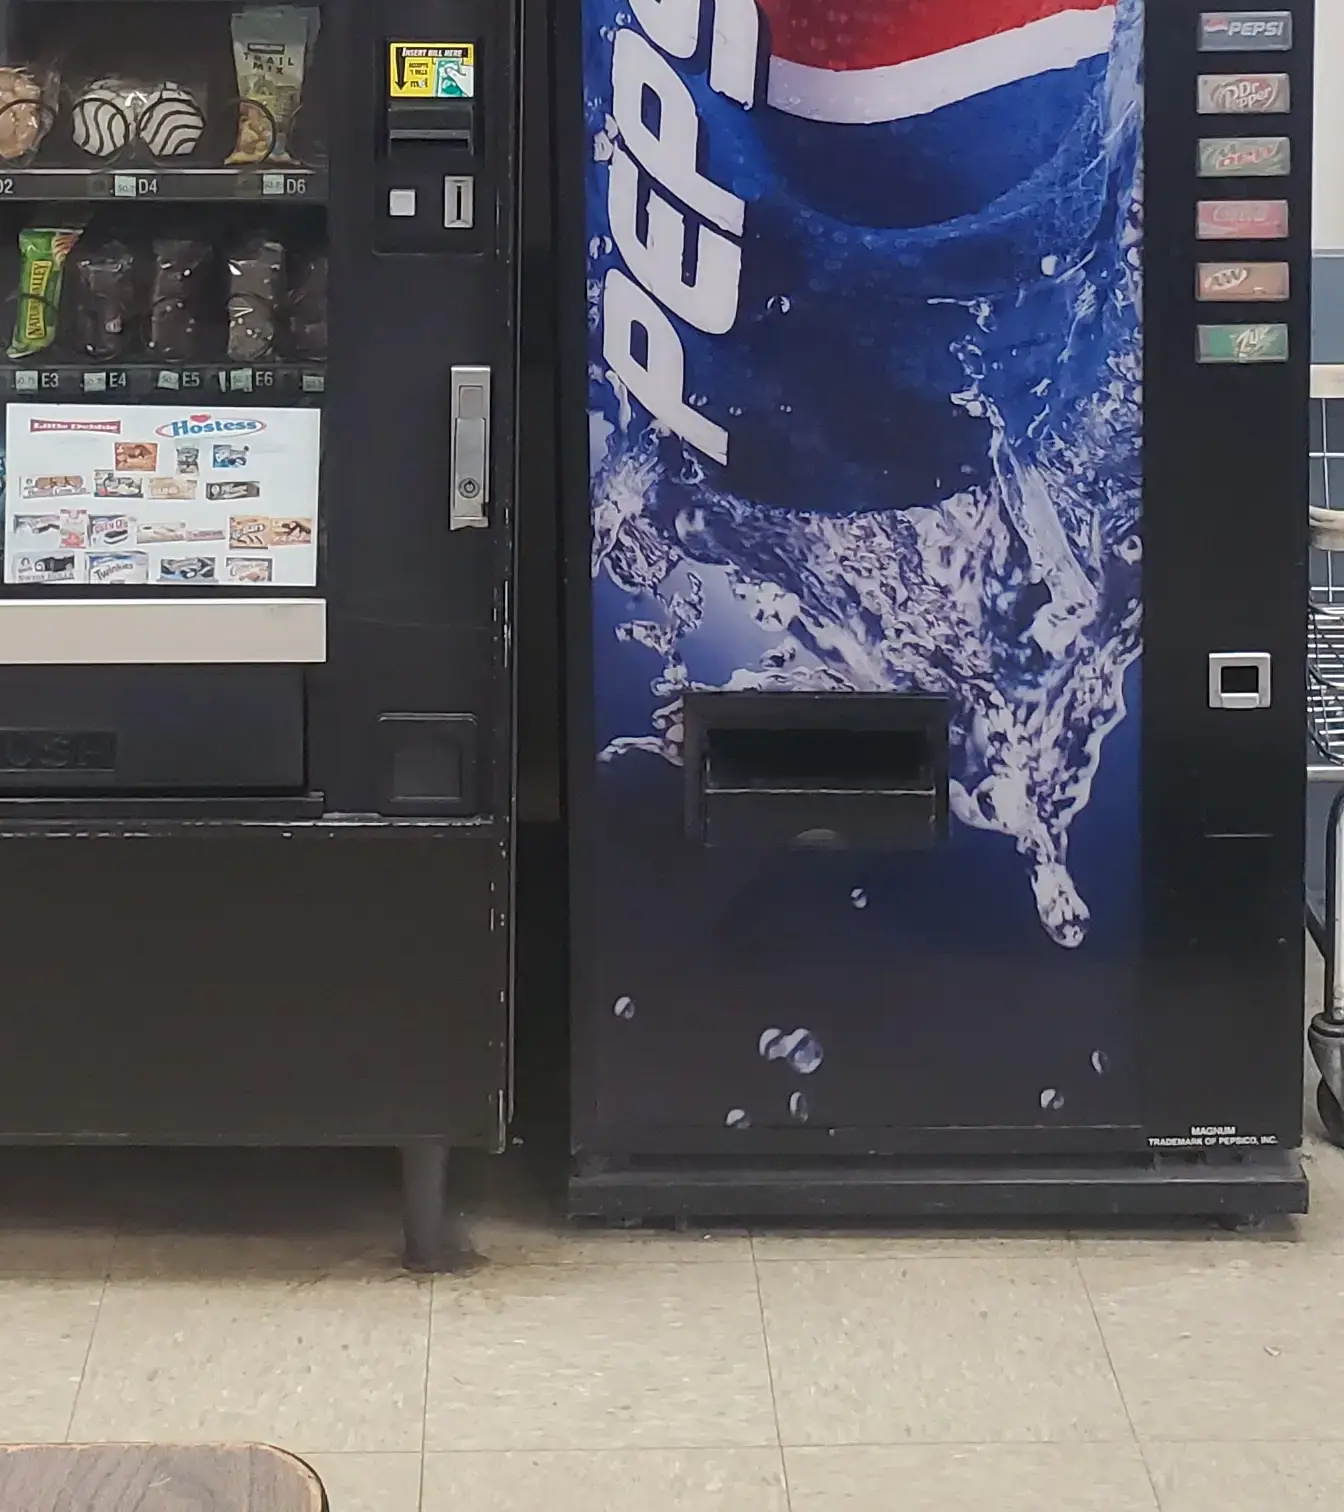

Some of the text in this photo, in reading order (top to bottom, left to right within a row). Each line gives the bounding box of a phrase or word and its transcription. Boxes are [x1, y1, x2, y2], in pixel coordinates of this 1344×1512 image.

[1228, 21, 1285, 37] PEPSI
[243, 51, 295, 67] TRAIL
[401, 47, 428, 57] INSERT
[428, 48, 443, 57] BILL
[252, 61, 285, 75] MIX
[1237, 80, 1259, 94] Dr
[1223, 86, 1272, 109] Pepper
[138, 178, 158, 195] D4
[286, 179, 306, 195] D6
[30, 262, 50, 295] ALLEY
[41, 372, 59, 388] E3
[109, 372, 127, 388] E4
[182, 372, 200, 387] E5
[255, 371, 273, 387] E6
[171, 418, 258, 438] Hostess
[1190, 1126, 1236, 1136] MAGNUM
[1148, 1137, 1203, 1147] TRADEMARK
[1204, 1137, 1217, 1146] OF
[1260, 1135, 1279, 1145] INC.
